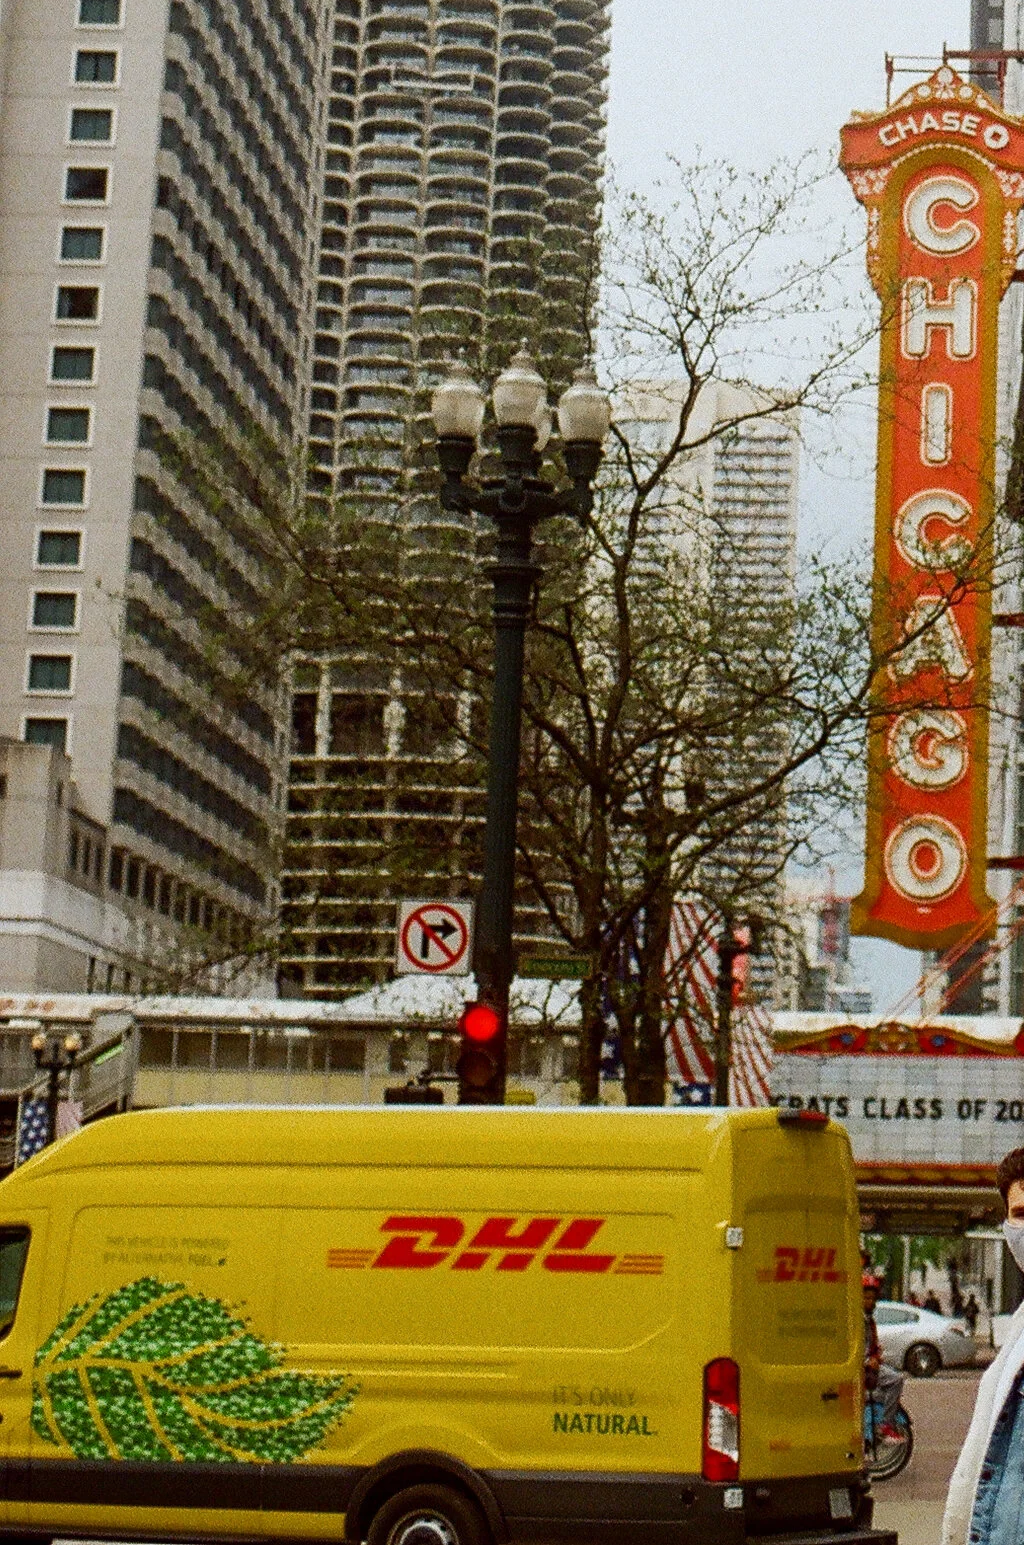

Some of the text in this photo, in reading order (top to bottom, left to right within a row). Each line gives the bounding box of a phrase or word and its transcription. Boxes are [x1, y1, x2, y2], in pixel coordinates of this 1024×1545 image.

[878, 112, 981, 146] CHASE
[884, 175, 982, 904] CHICAGO
[863, 1097, 942, 1120] CLASS
[957, 1098, 987, 1121] OF
[372, 1216, 616, 1272] DHL
[774, 1246, 840, 1284] DHL
